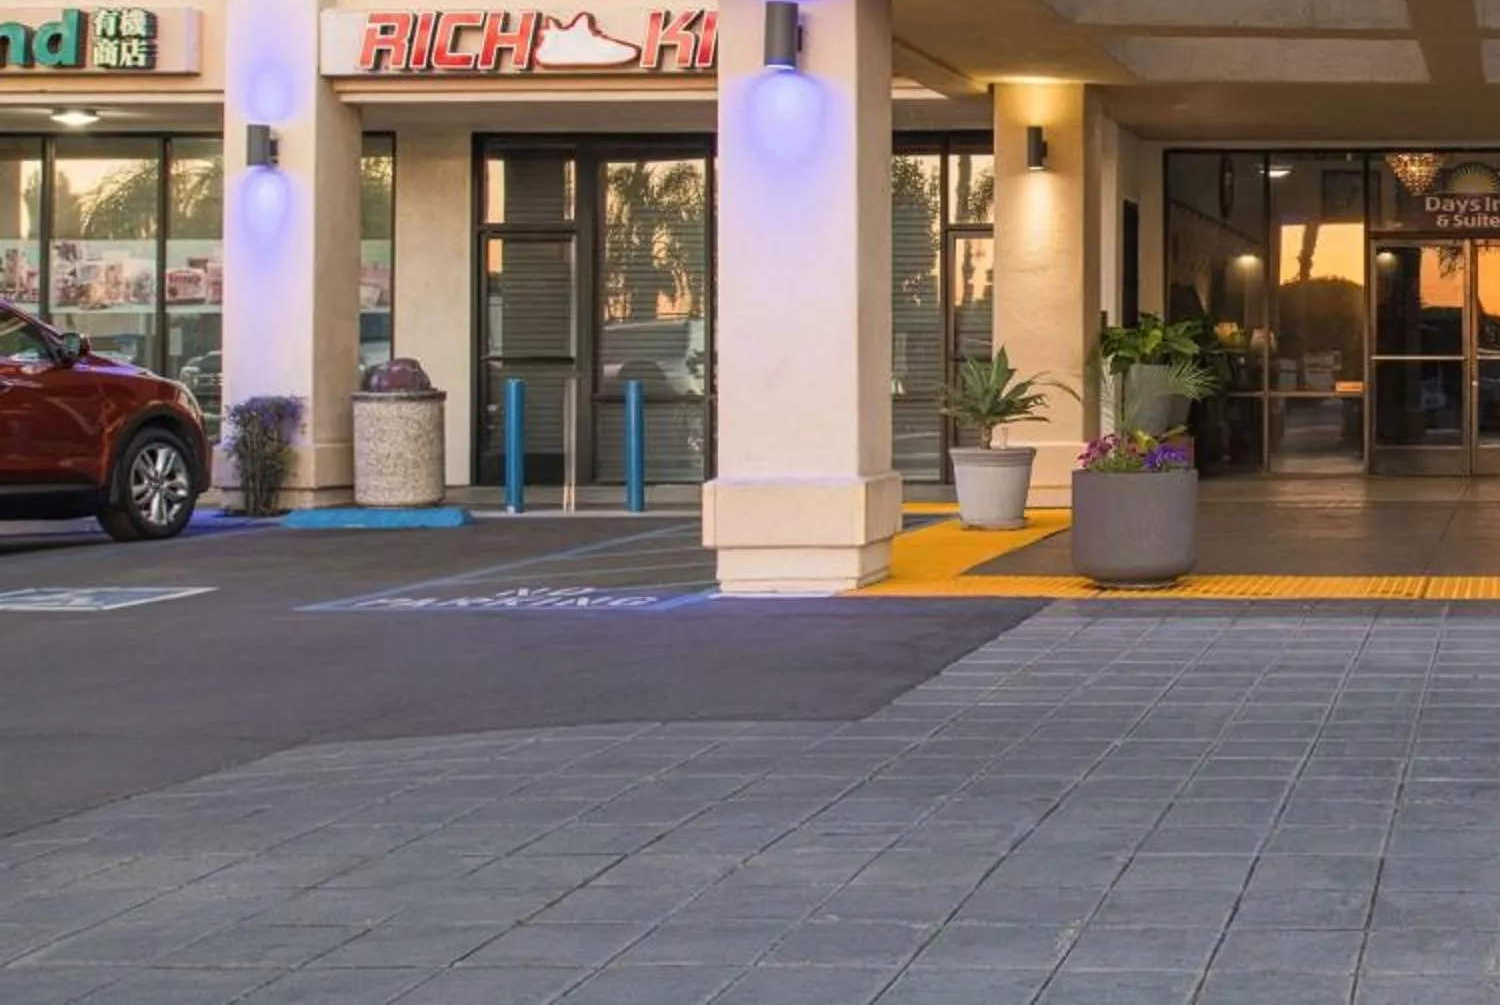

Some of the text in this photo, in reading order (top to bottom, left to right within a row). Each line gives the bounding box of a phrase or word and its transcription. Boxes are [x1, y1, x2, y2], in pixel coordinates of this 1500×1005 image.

[359, 9, 537, 69] RICH
[93, 39, 148, 67] 商店
[1424, 196, 1480, 214] Days
[1436, 214, 1450, 228] &
